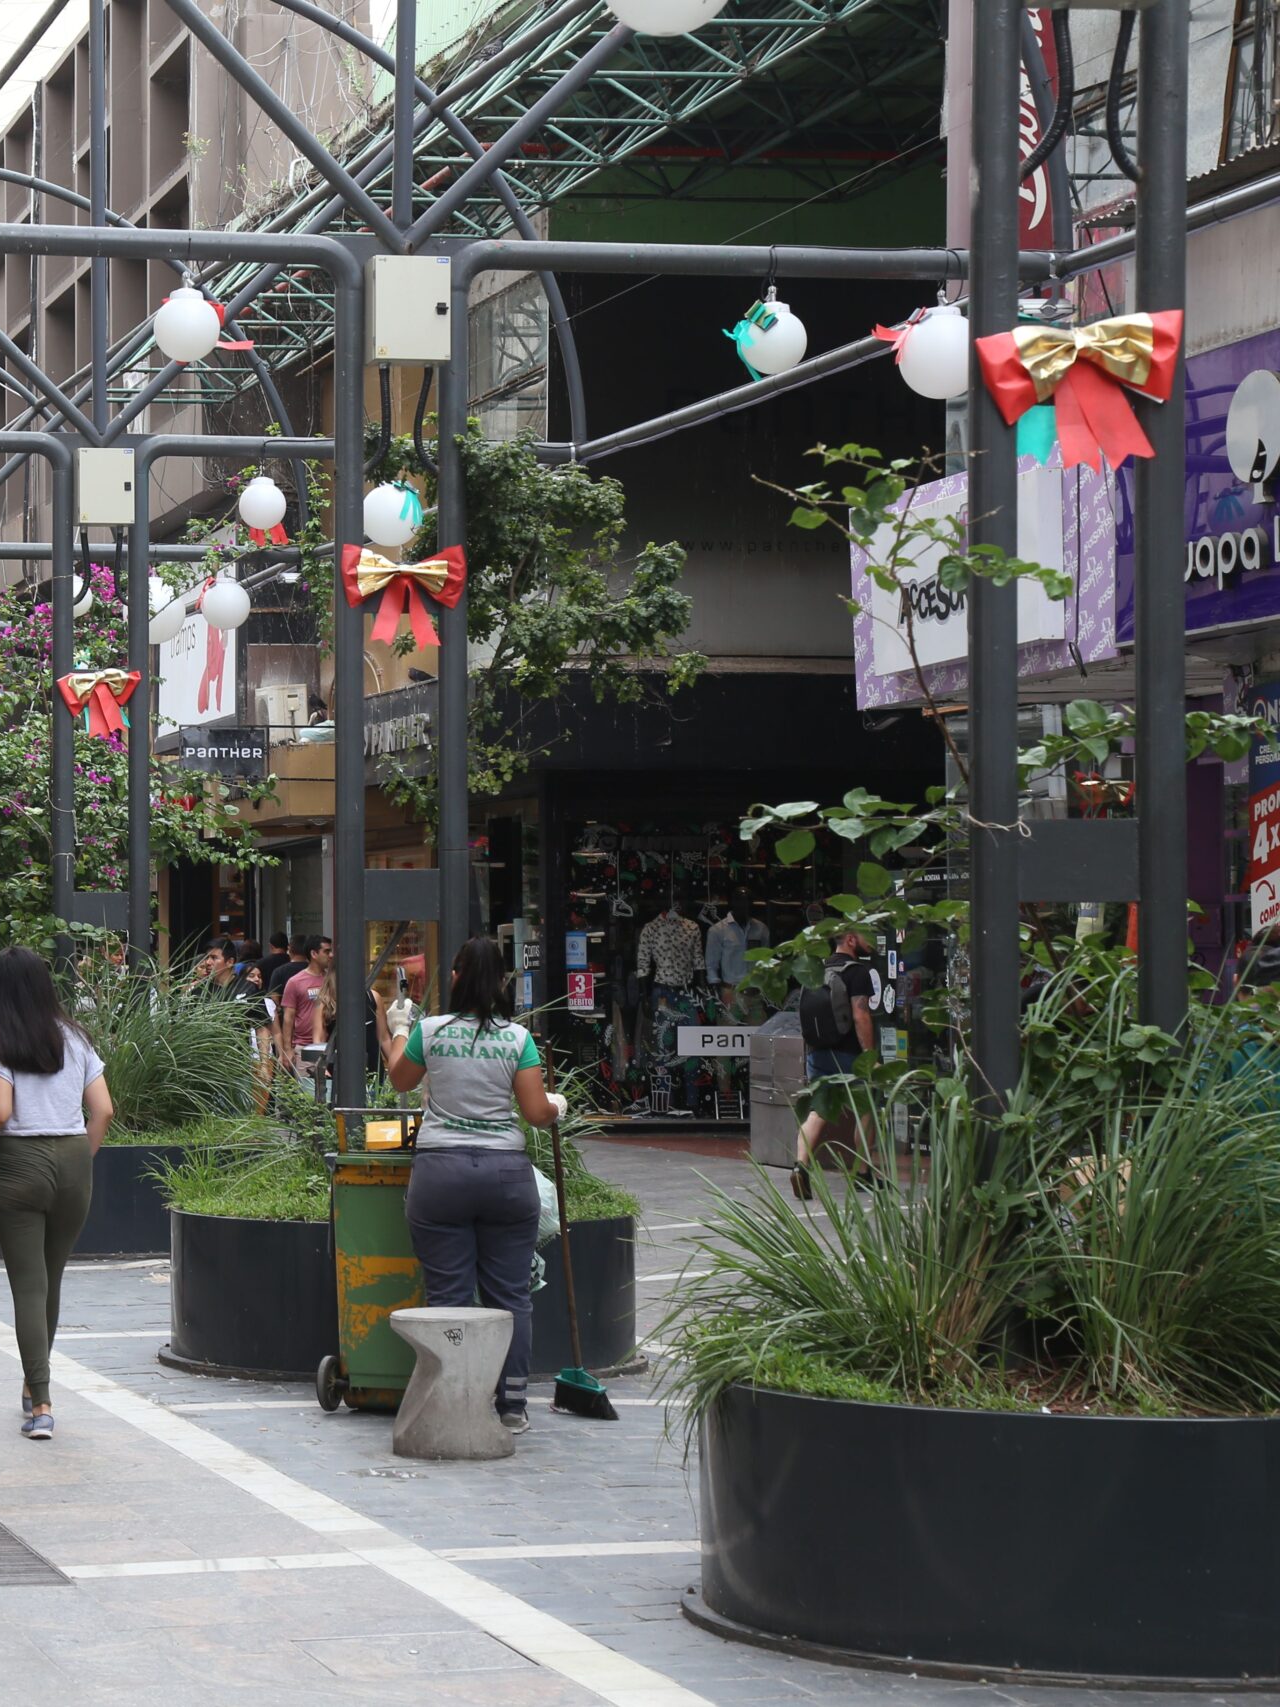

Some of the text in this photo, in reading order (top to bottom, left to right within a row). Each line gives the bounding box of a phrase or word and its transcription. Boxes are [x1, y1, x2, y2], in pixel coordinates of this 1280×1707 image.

[900, 576, 965, 625] ACCESO
[1260, 902, 1280, 925] COMP
[575, 974, 586, 993] 3
[435, 1026, 517, 1042] CENTRO
